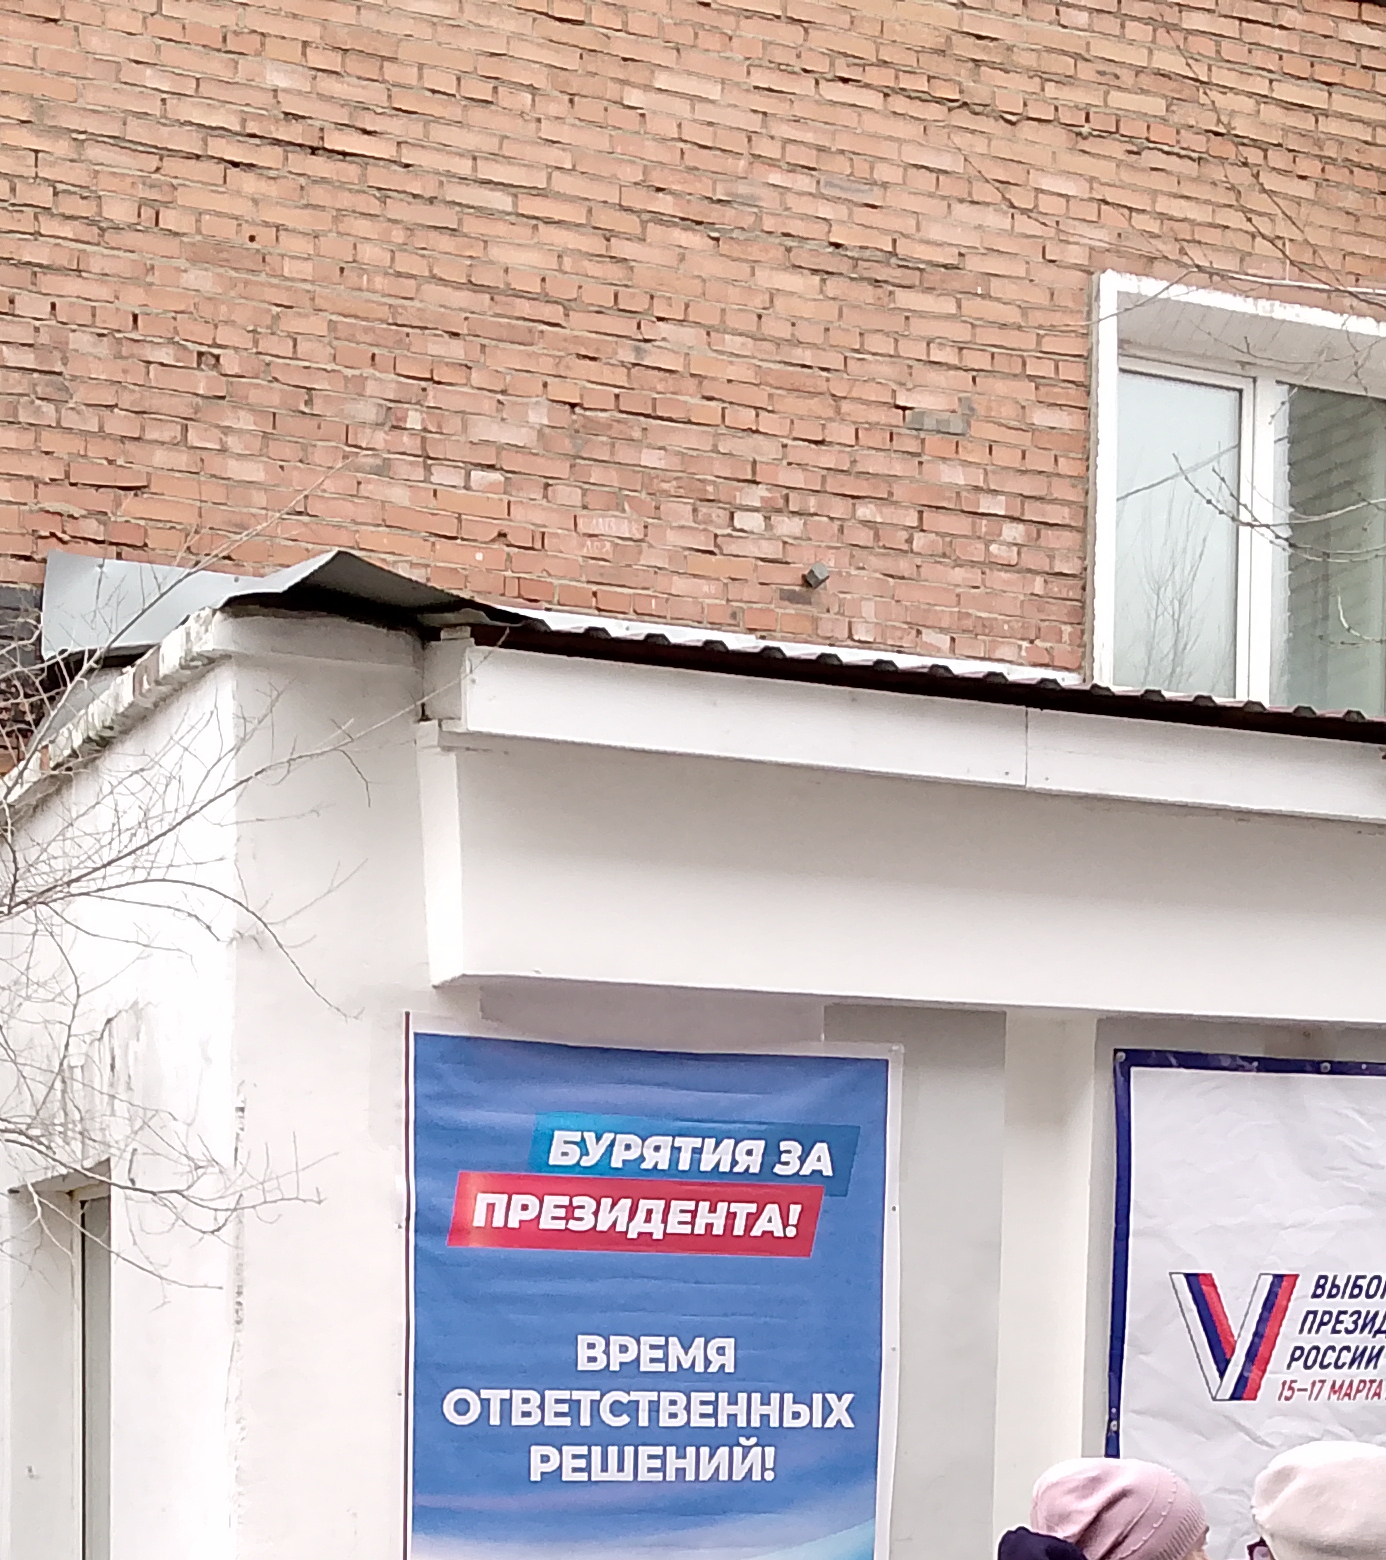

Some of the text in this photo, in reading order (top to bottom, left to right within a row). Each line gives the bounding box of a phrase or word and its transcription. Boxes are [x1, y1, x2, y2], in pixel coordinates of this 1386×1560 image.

[547, 1130, 834, 1177] БУРЯТИЯ ЗА
[472, 1192, 803, 1240] ПРЕЗИДЕНТА!
[576, 1334, 736, 1374] ВРЕМЯ
[1286, 1345, 1386, 1370] РОССИИ
[442, 1388, 855, 1429] ОТВЕТСТВЕННЫХ
[1328, 1379, 1383, 1401] МАРТА
[529, 1436, 776, 1482] РЕШЕНИЙ!
